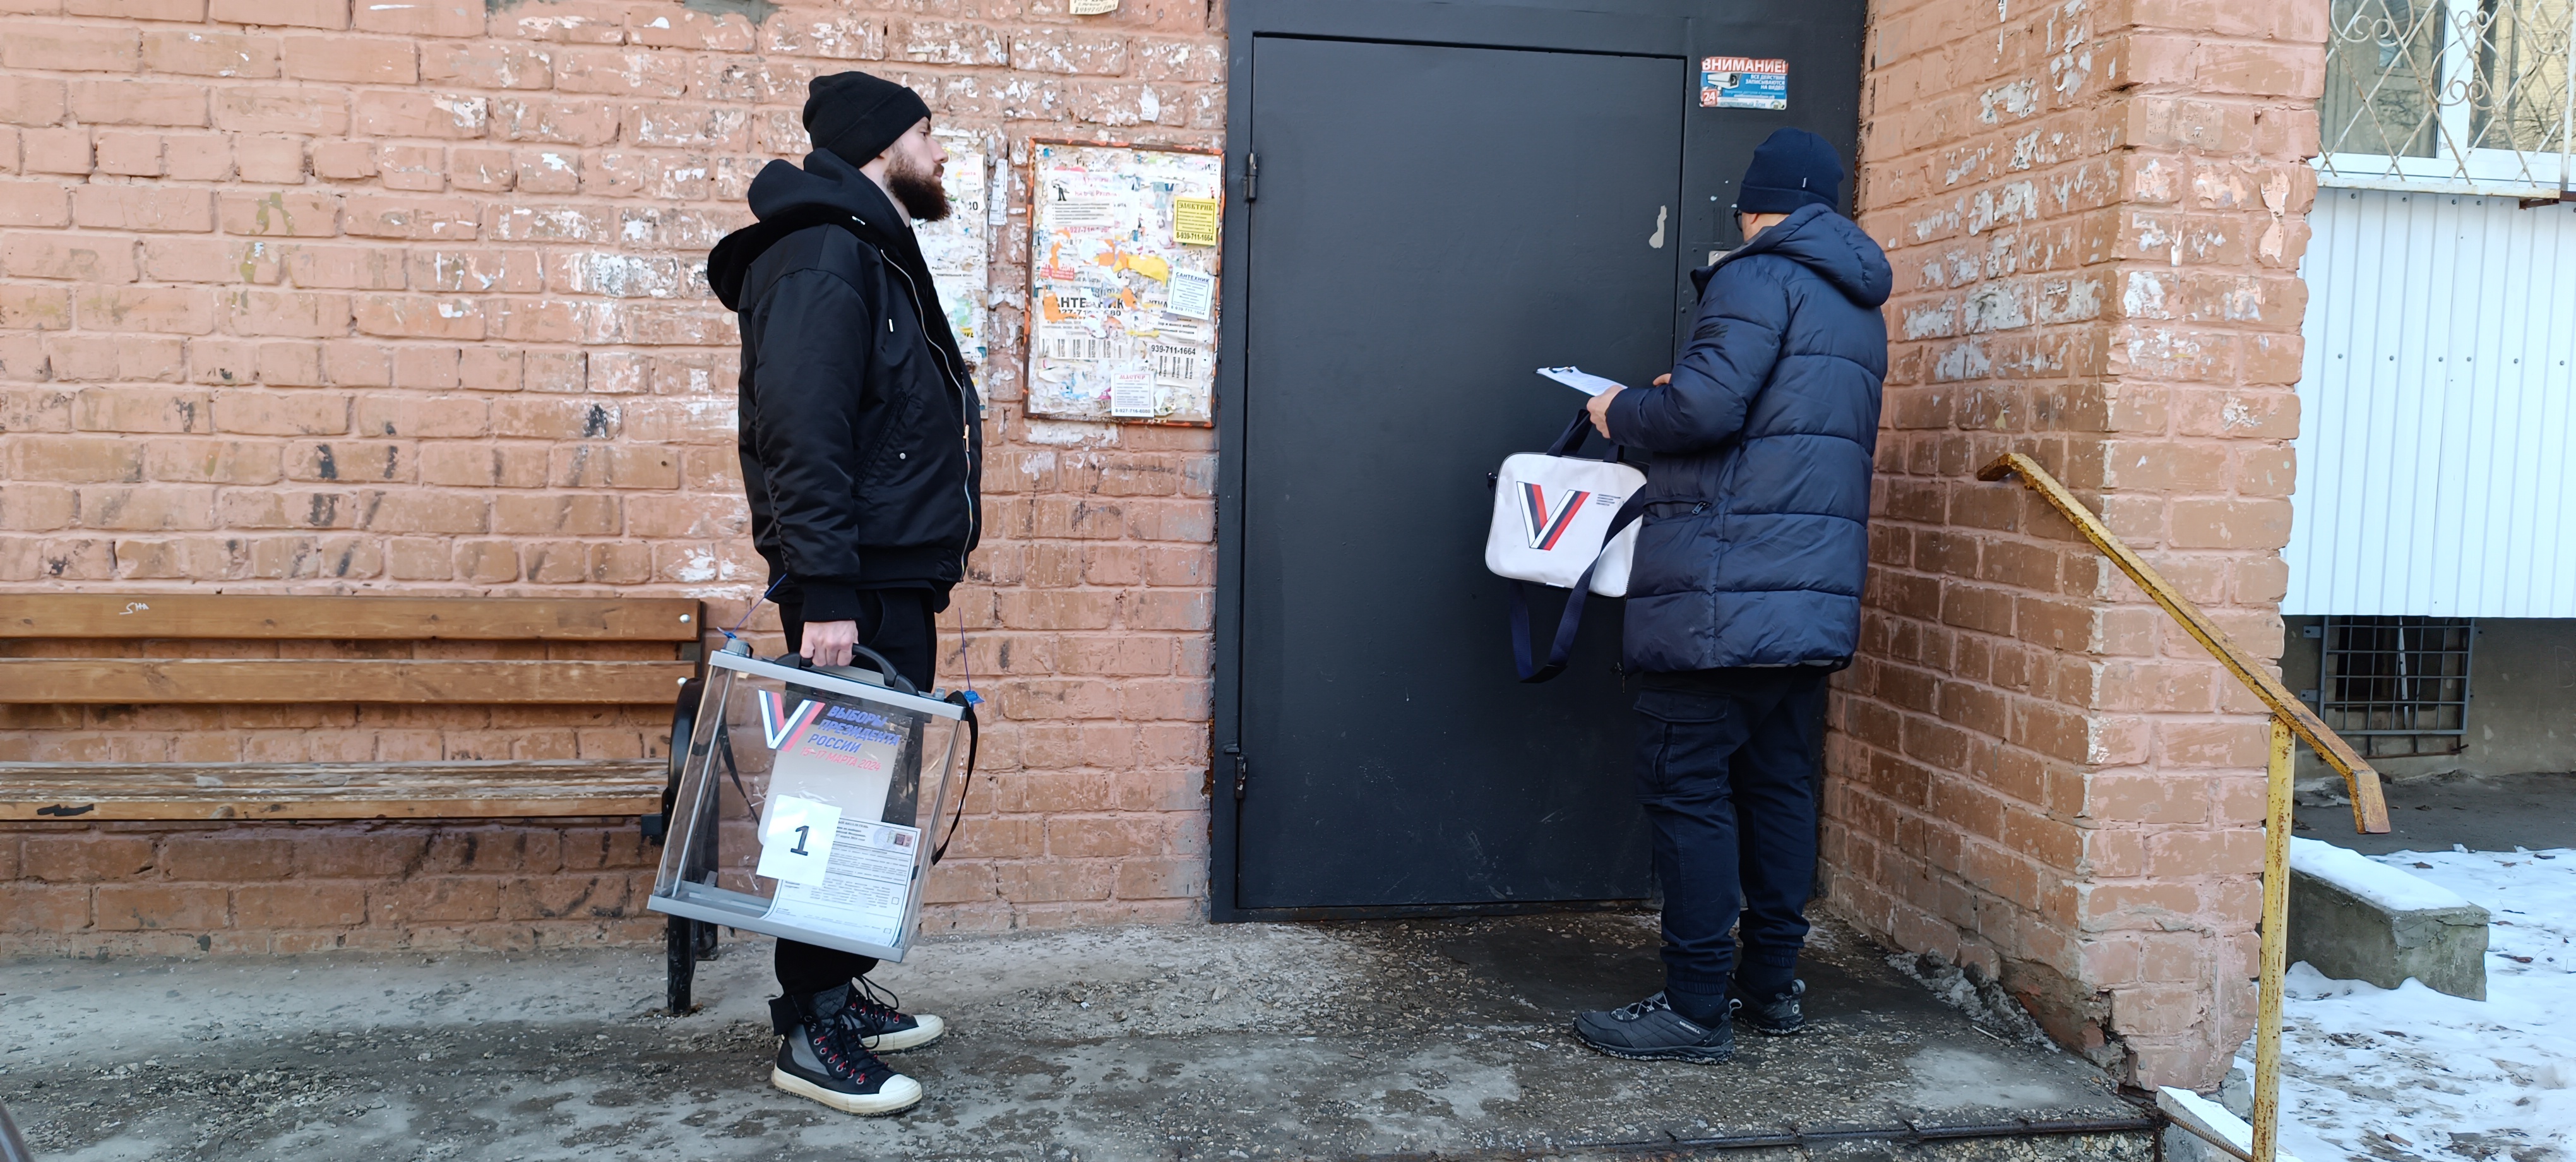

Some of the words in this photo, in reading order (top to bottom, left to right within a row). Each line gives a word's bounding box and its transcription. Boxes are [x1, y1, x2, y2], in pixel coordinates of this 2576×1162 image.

[1702, 58, 1786, 73] ВНИМАНИЕ!
[1703, 92, 1715, 100] 24
[1178, 202, 1213, 211] ЭЛЕКТРИК
[1176, 231, 1213, 241] 8-939-711-1664
[1176, 272, 1210, 282] САНТЕХНИК
[1151, 344, 1196, 355] 939-711-1664
[826, 705, 888, 727] ВЫБОРЫ
[818, 719, 901, 746] ПРЕЗИДЕНТА
[807, 733, 862, 753] РОССИИ
[825, 752, 859, 767] МАРТА
[857, 759, 881, 771] 2024
[790, 825, 810, 856] 1
